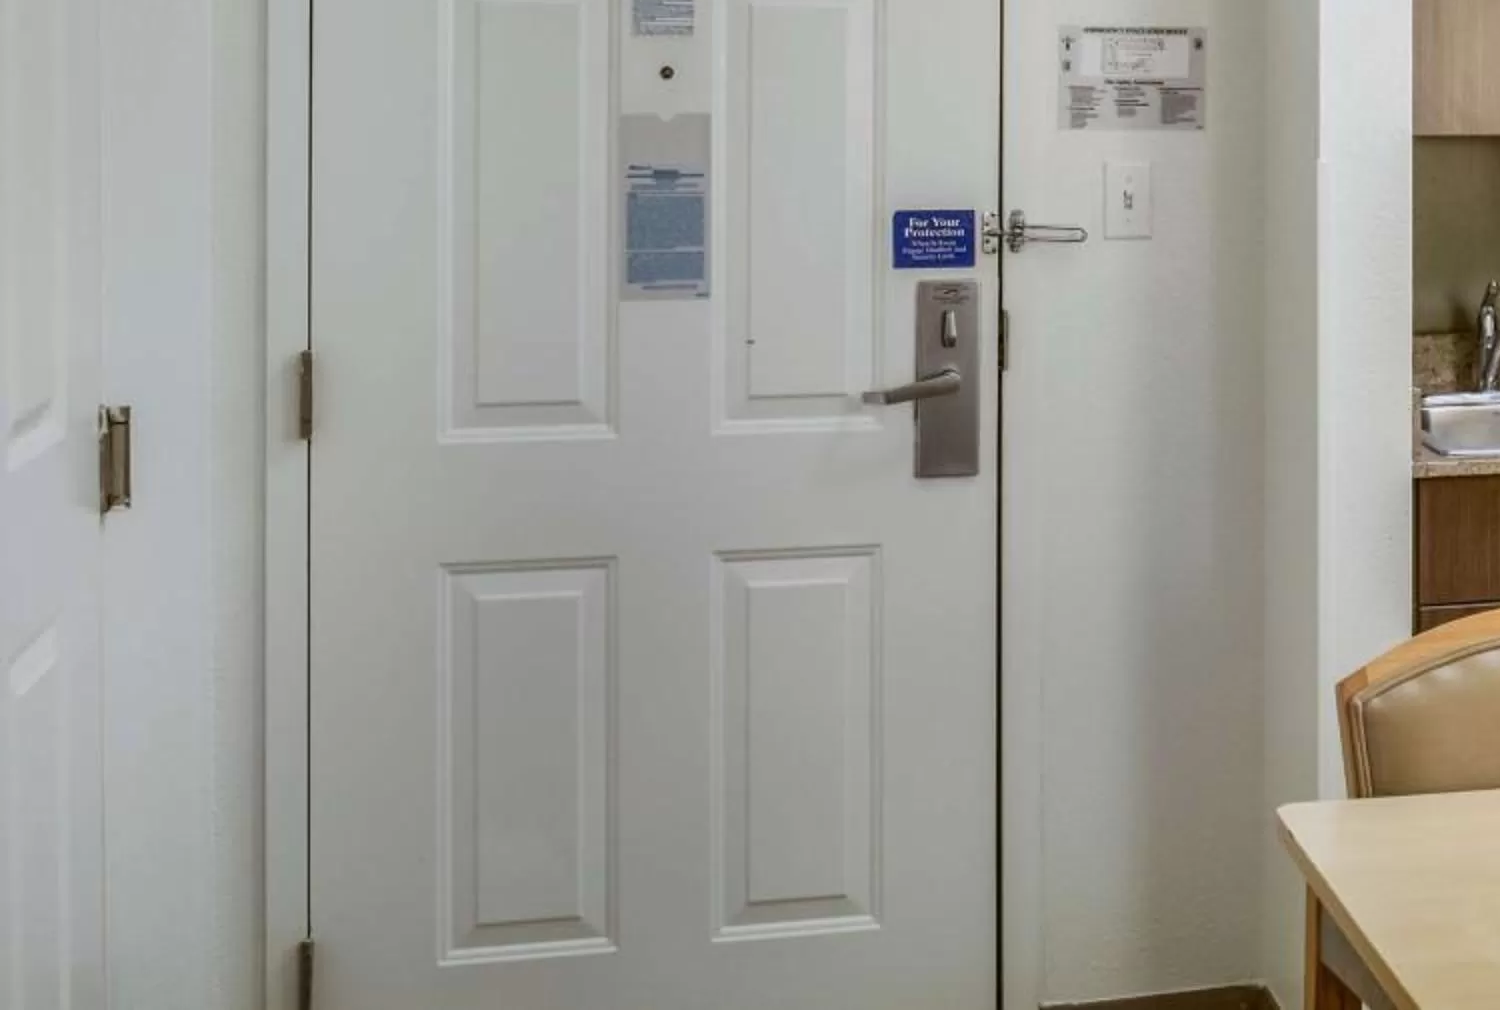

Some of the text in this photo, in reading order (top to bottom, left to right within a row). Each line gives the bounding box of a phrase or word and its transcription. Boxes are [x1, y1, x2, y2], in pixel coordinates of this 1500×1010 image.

[909, 216, 960, 227] For Your
[904, 227, 965, 238] Protection
